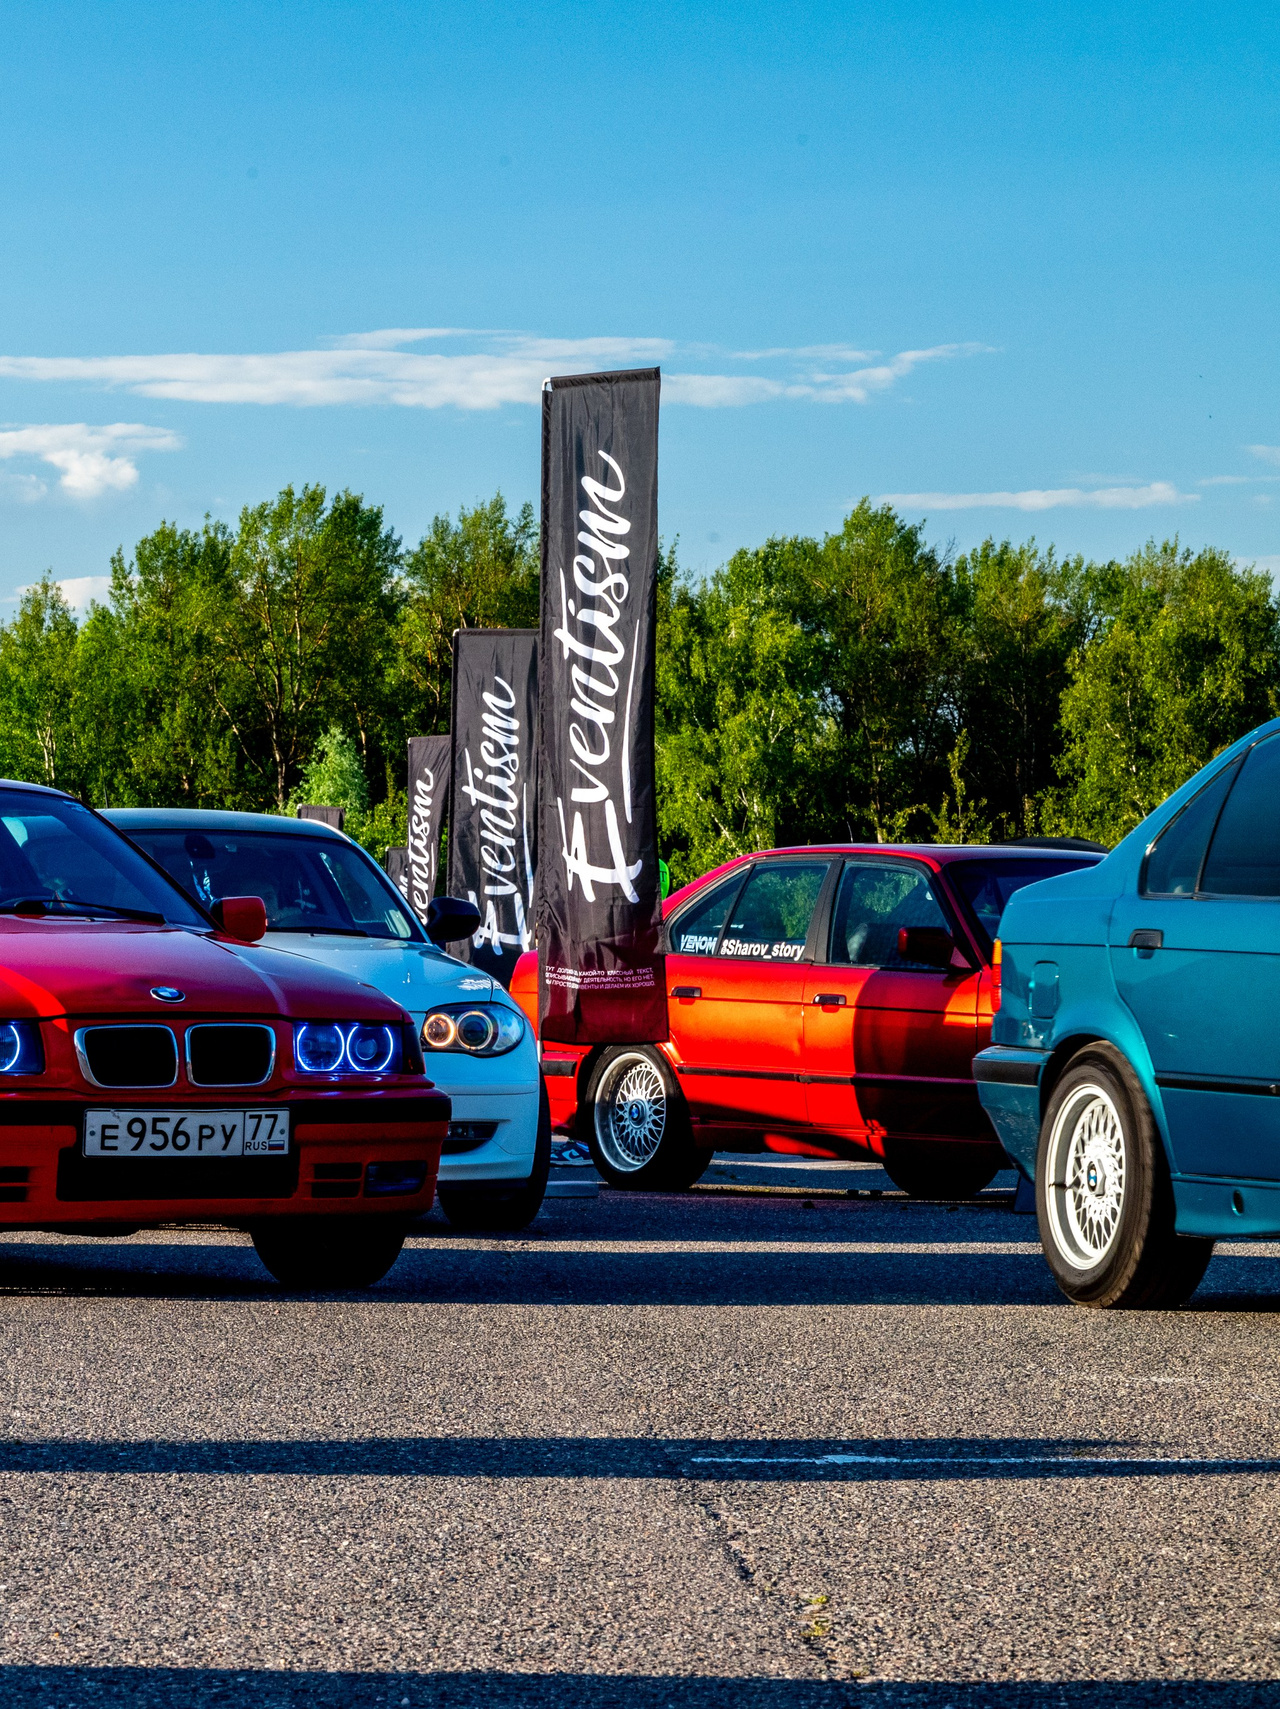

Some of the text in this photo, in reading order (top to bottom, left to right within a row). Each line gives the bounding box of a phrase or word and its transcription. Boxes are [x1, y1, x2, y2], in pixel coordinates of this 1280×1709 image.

[554, 449, 642, 904] Eventism
[408, 767, 435, 927] ventism
[461, 675, 534, 956] Eventism
[680, 934, 718, 955] VENOM
[245, 1141, 267, 1151] RUS
[248, 1114, 279, 1140] 77
